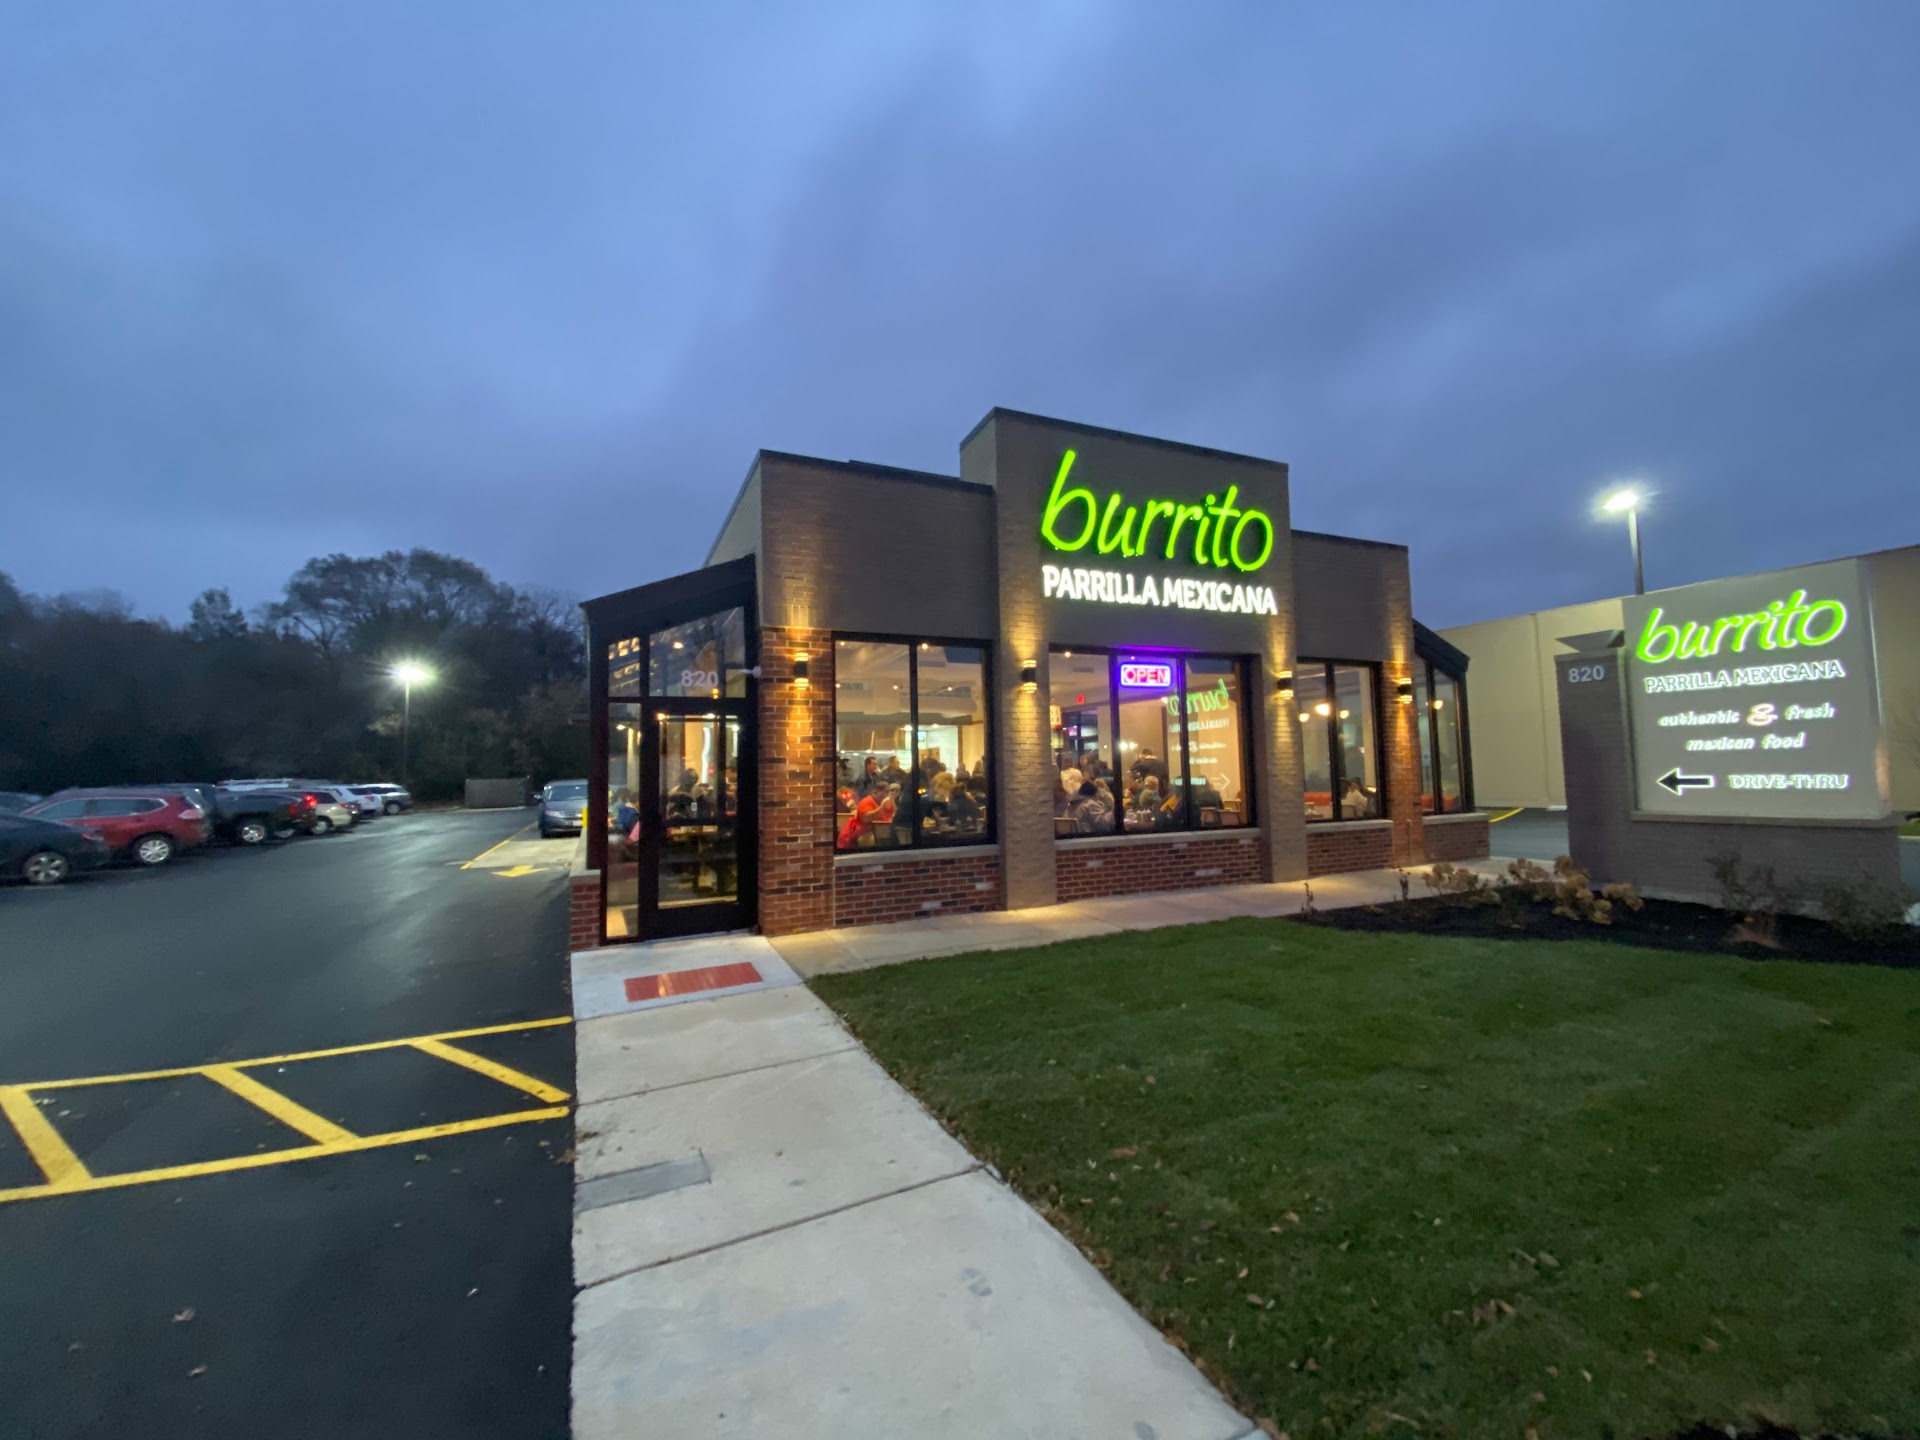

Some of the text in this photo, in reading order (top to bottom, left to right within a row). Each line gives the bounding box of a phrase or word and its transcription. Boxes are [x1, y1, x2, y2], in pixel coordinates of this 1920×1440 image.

[1042, 450, 1273, 571] burrito
[1042, 564, 1278, 615] PARRILLA MEXICANA
[1636, 589, 1848, 664] burrito
[681, 669, 719, 689] 820
[1123, 667, 1168, 684] OPEN
[1568, 665, 1605, 683] 820
[1644, 659, 1846, 694] PARRILLA MEXICANA
[1658, 702, 1836, 727] authentic & fresh
[1686, 732, 1806, 751] mexican food
[1729, 773, 1849, 790] DRIVE-THRU
